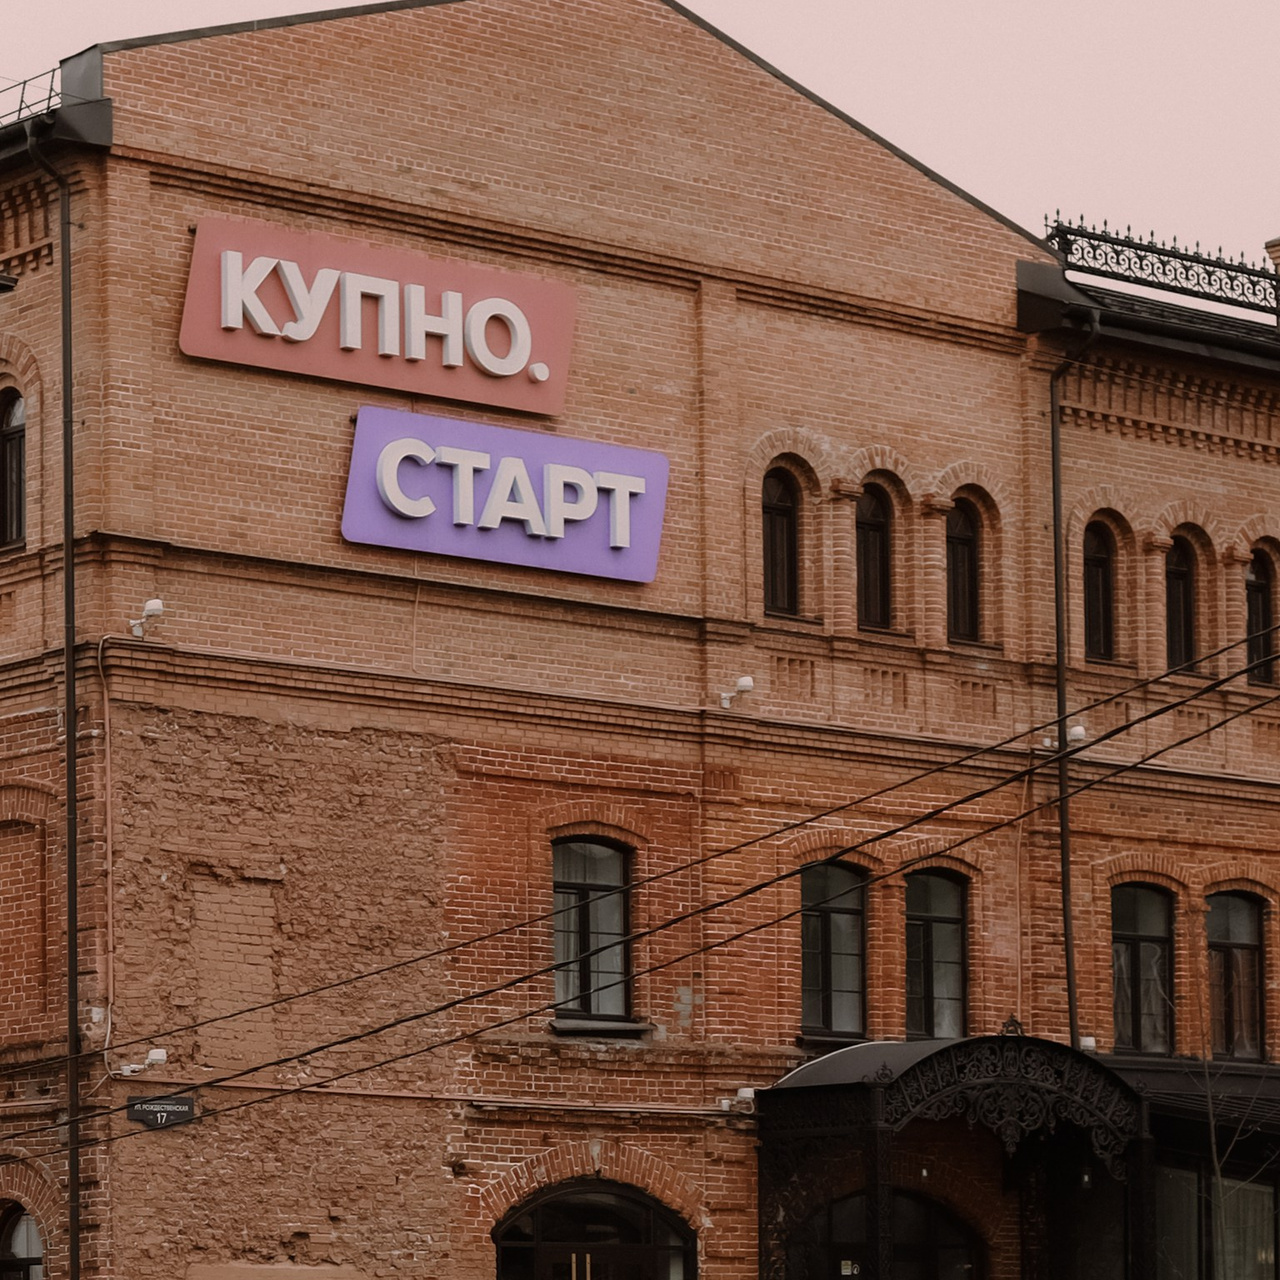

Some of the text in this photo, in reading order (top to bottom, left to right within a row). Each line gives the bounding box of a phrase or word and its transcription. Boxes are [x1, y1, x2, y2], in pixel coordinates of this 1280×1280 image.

[221, 249, 550, 382] КУПНО.
[376, 438, 646, 549] СТАРТ
[157, 1113, 167, 1123] 17
